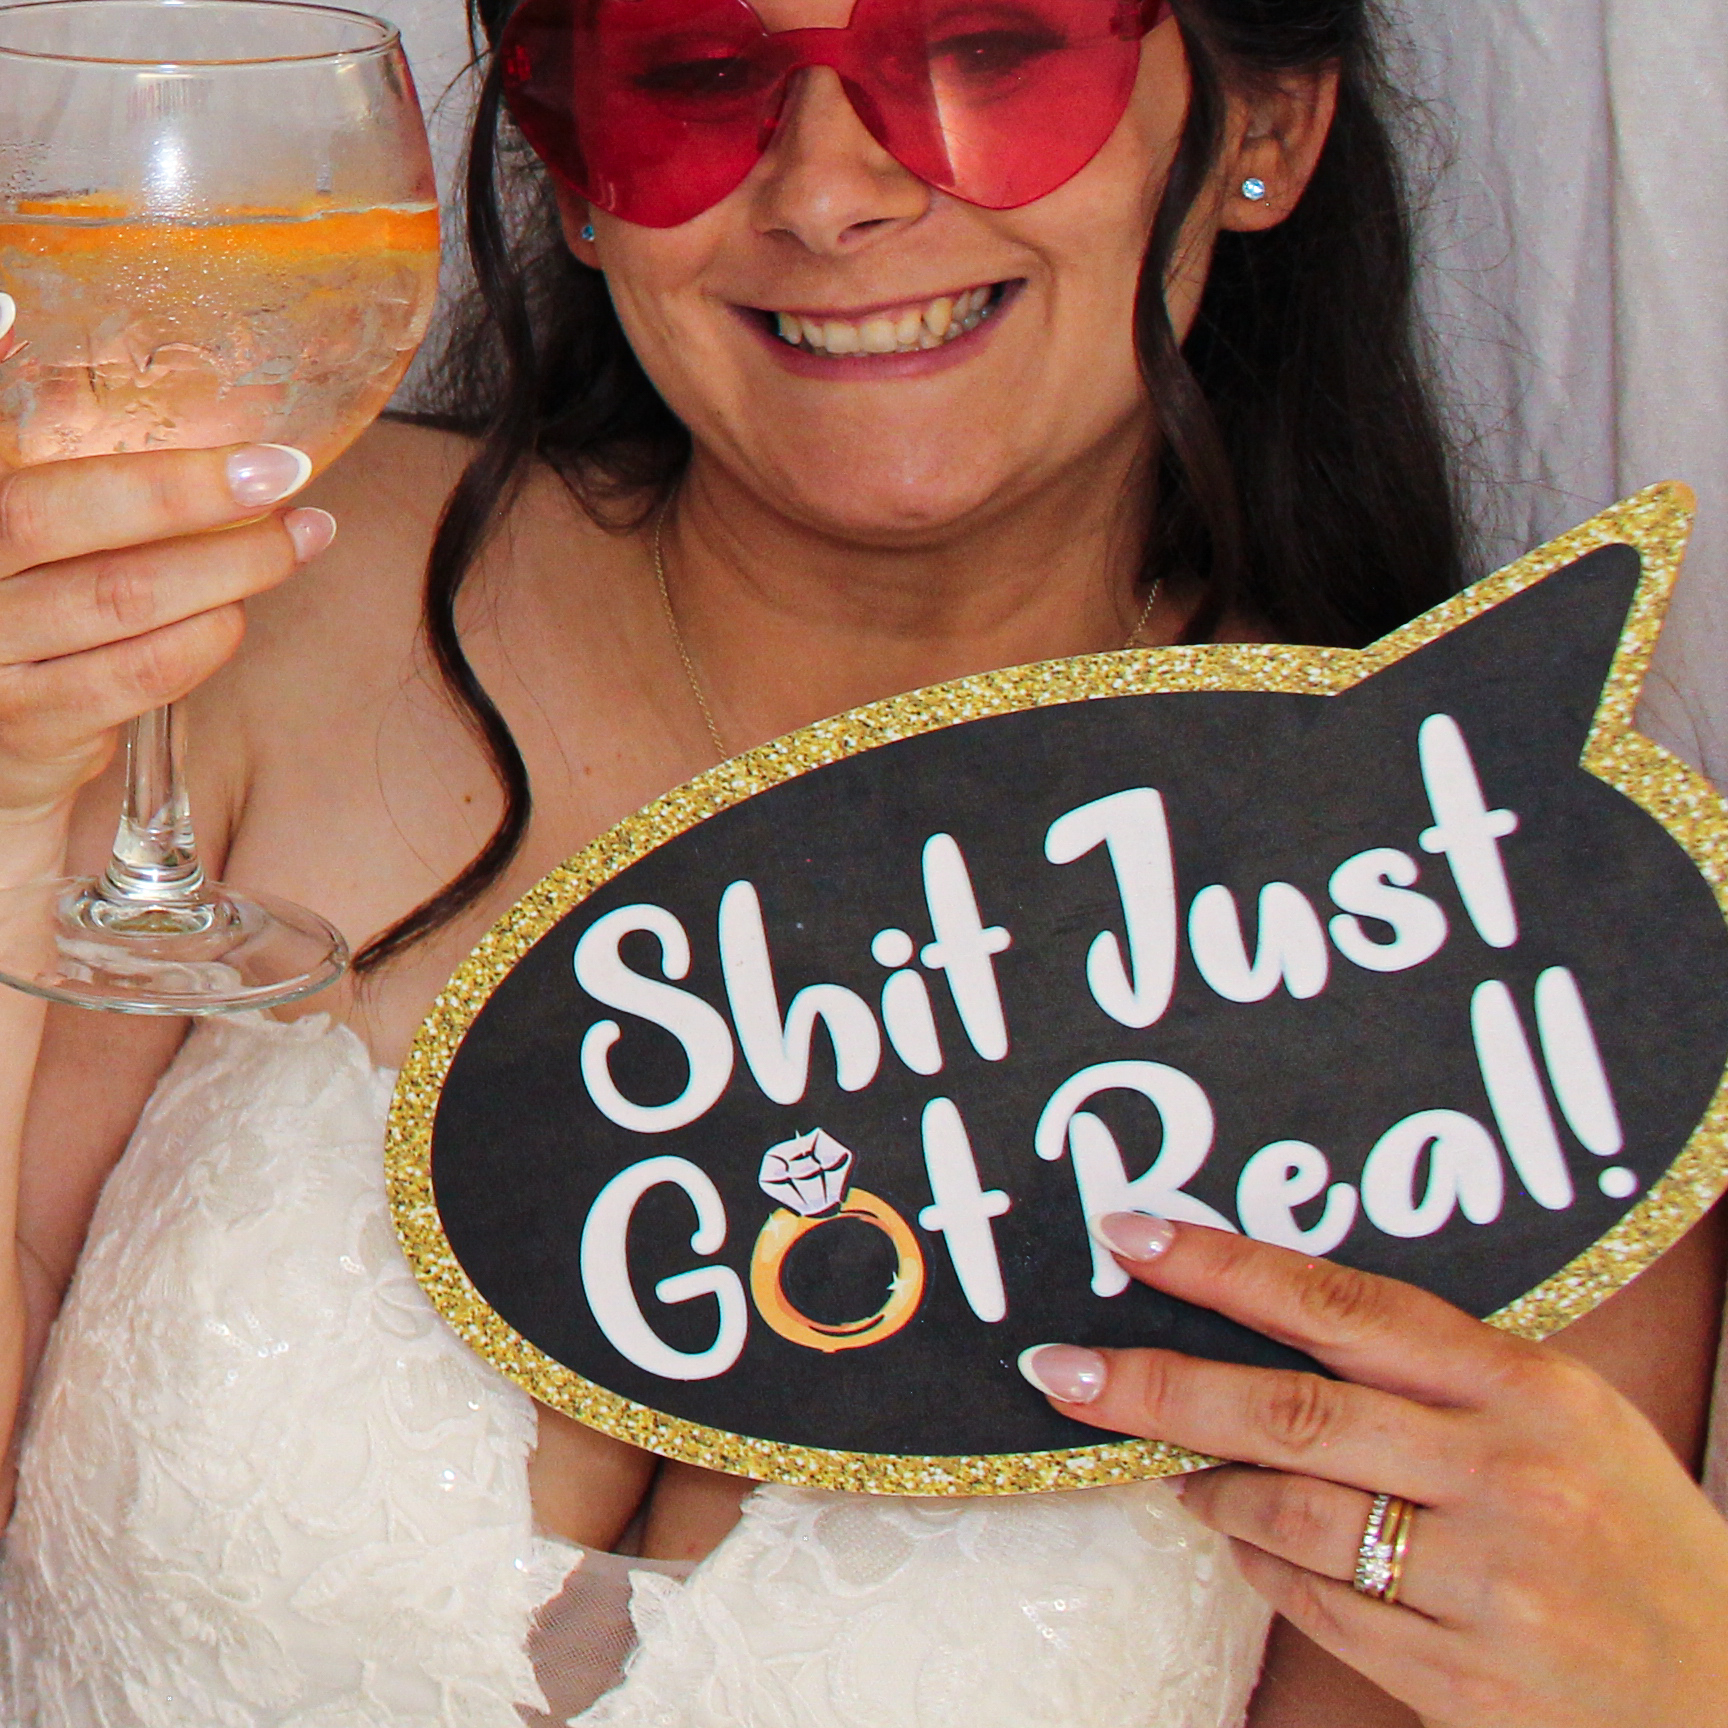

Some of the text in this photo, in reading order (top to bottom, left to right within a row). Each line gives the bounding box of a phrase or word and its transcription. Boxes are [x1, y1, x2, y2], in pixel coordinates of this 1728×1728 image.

[573, 713, 1517, 1133] Shit Just
[1034, 966, 1638, 1298] Real!
